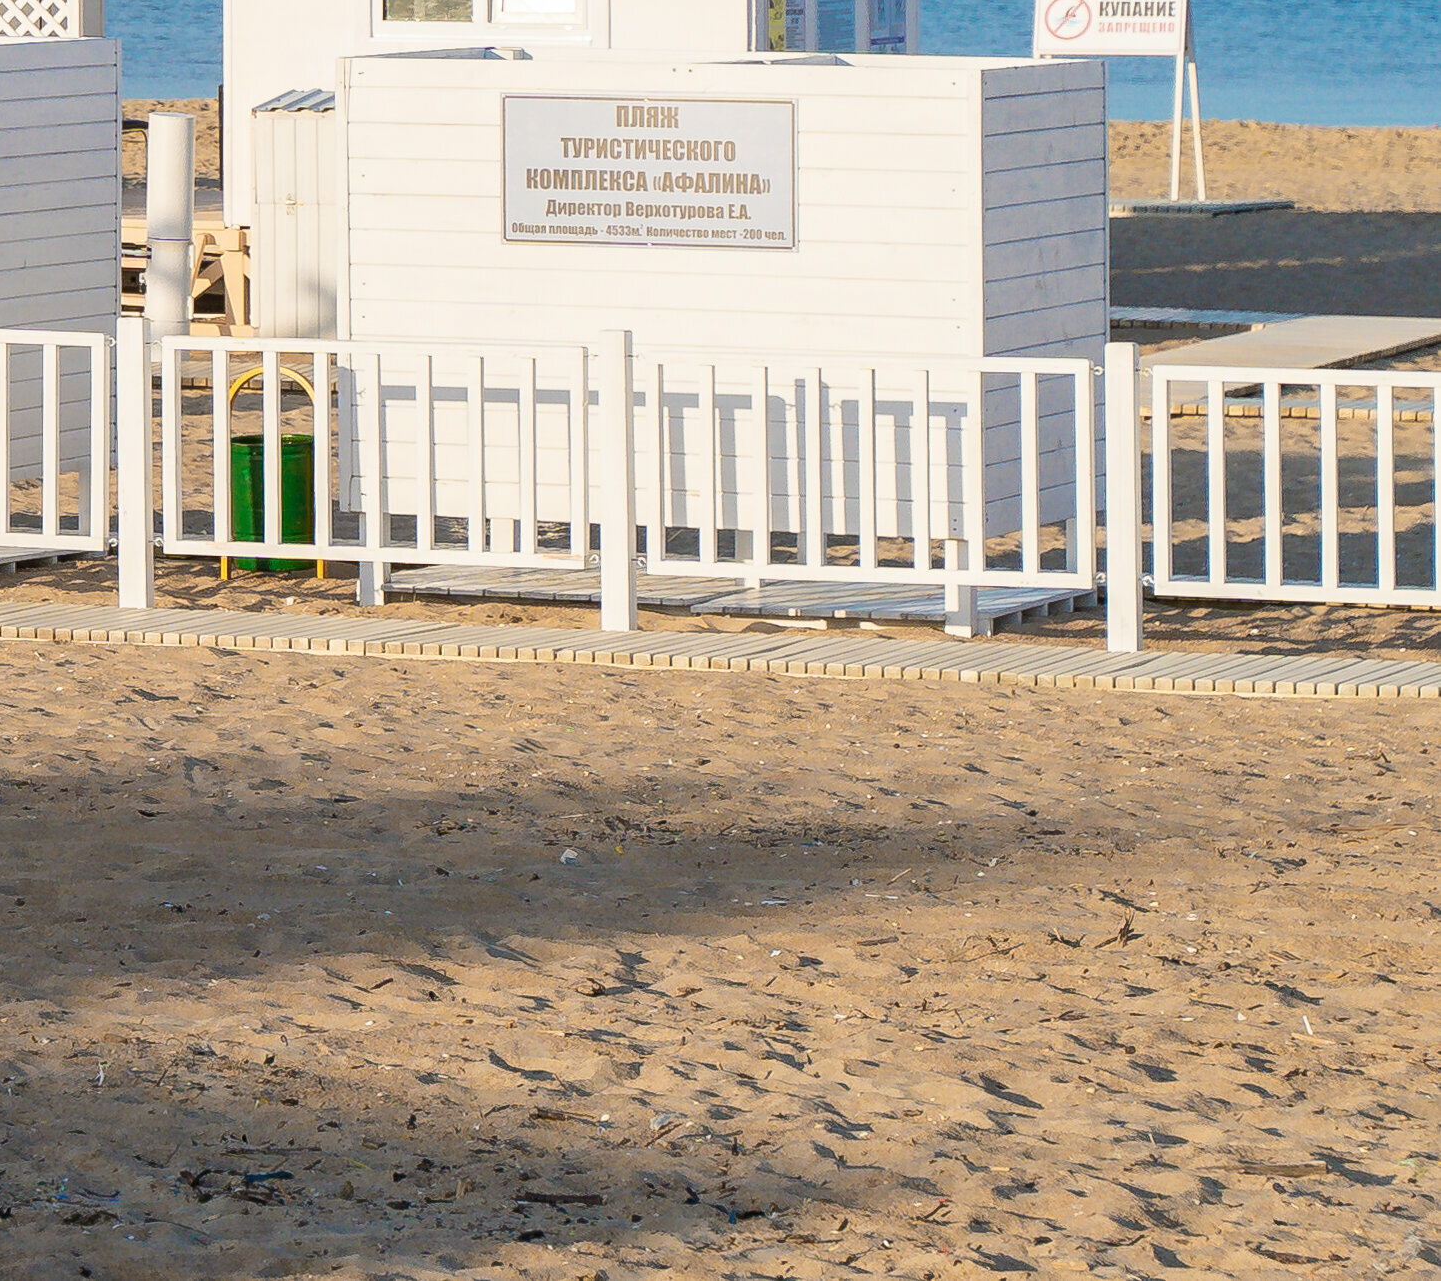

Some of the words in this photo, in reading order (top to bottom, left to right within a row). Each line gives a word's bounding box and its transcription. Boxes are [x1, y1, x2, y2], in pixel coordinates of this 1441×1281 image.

[1098, 1, 1176, 17] КУПАНИЕ
[1098, 22, 1175, 34] ЗАПРЕЩЕНО
[616, 105, 680, 129] ПЛЯЖ
[560, 137, 736, 161] ТУРИСТИЧЕСКОГО
[526, 168, 648, 192] КОМПЛЕКСА
[653, 171, 771, 195] «АФАЛИНА»
[545, 199, 621, 218] Директор
[627, 201, 724, 220] Верхотурова
[728, 204, 752, 220] Е.А.
[511, 222, 547, 235] Общая
[548, 224, 598, 237] площадь
[646, 226, 710, 239] Количество
[711, 228, 737, 239] мест
[764, 229, 787, 241] чел.
